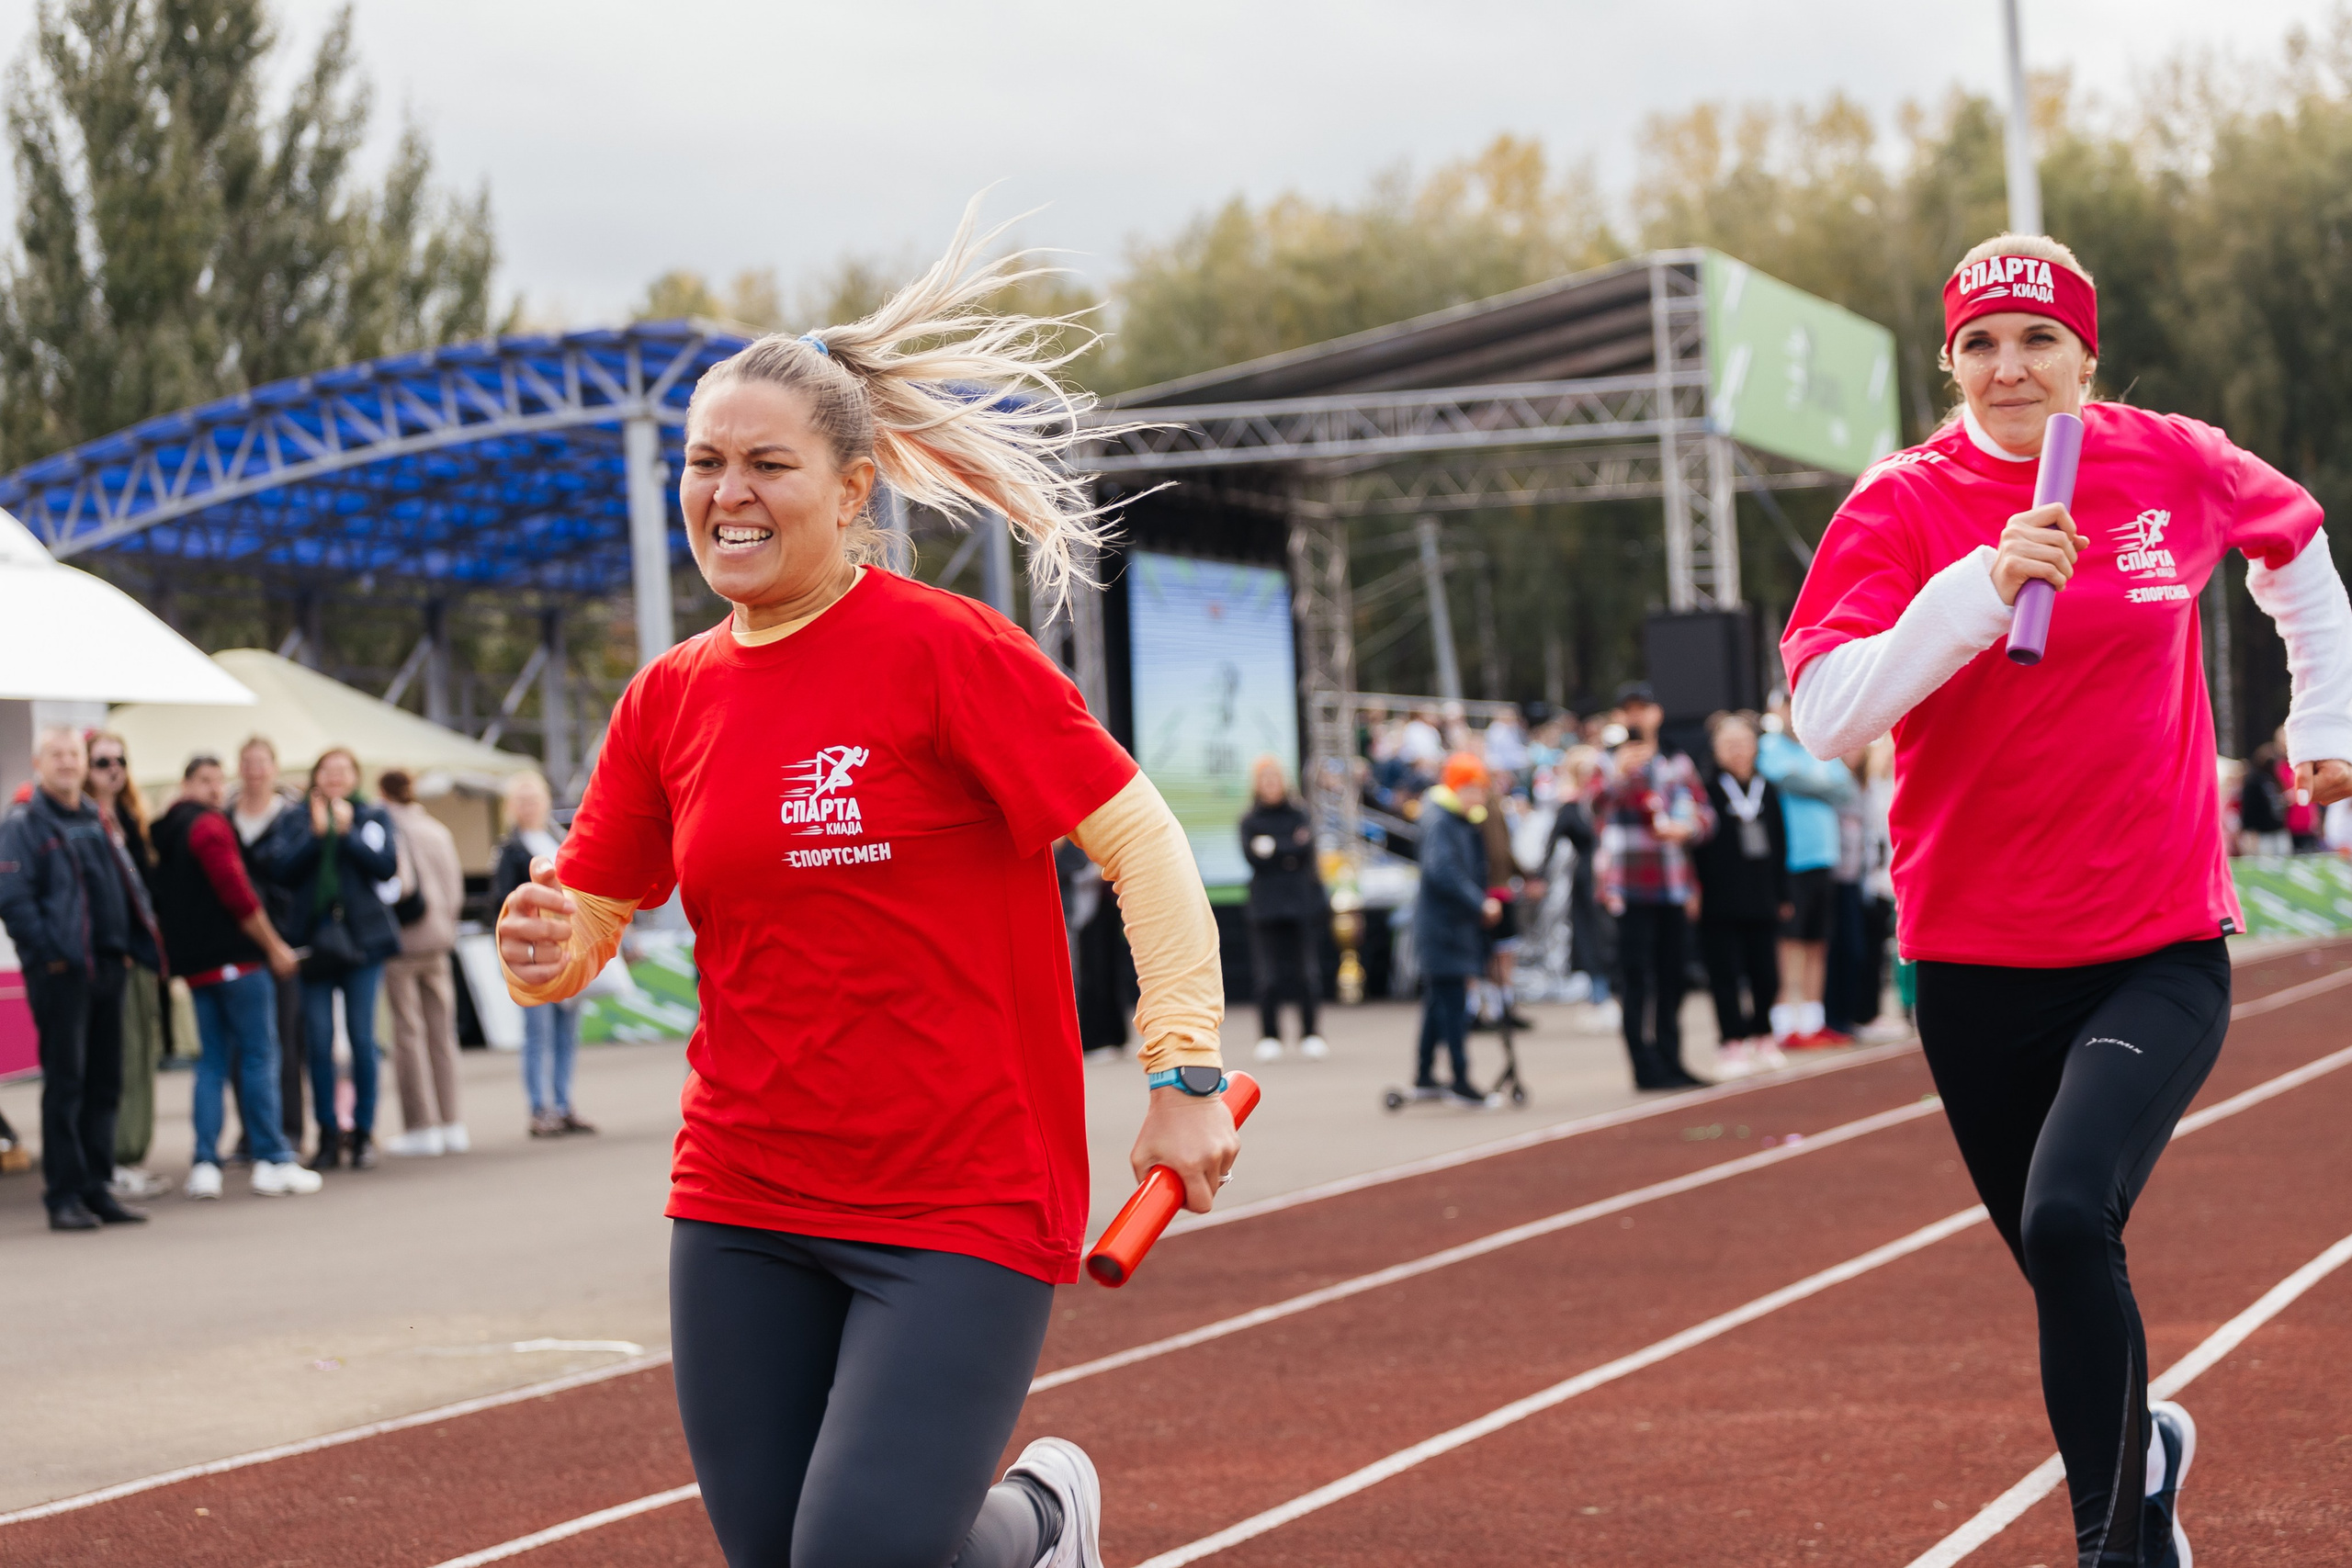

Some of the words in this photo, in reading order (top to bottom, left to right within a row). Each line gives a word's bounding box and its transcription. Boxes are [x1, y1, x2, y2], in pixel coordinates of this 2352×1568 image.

[1959, 255, 2054, 295] СПАРТА
[2012, 283, 2054, 303] КИАДА
[2116, 549, 2176, 572] СПАРТА
[781, 797, 862, 824] СПАРТА
[826, 821, 864, 836] КИАДА
[788, 842, 892, 868] СПОРТСМЕН
